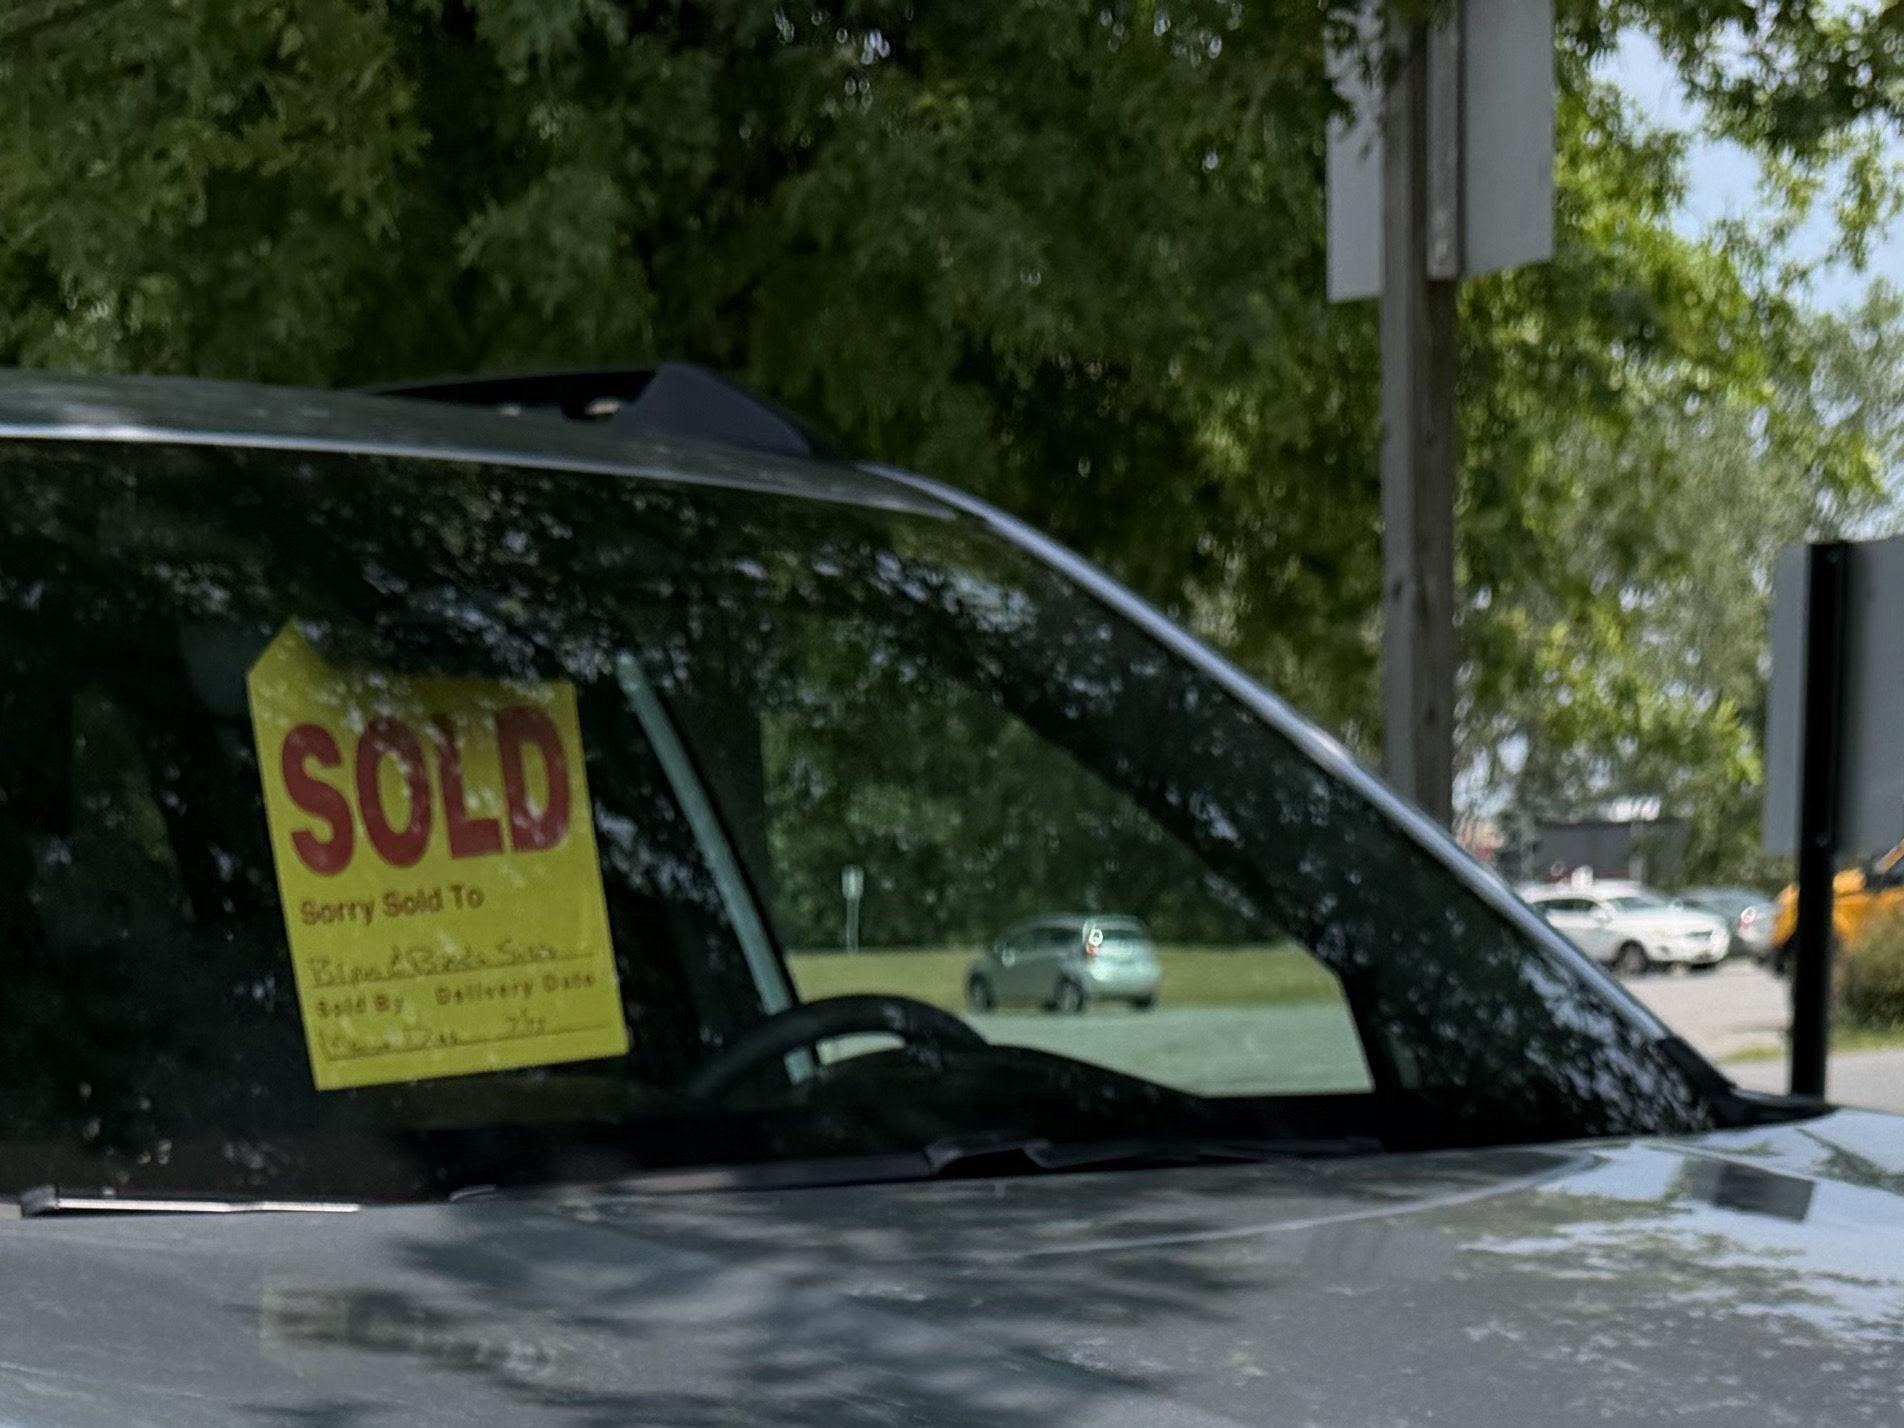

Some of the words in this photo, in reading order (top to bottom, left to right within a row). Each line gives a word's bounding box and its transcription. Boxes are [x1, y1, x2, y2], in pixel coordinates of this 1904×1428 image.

[282, 707, 569, 876] SOLD
[300, 899, 375, 926] Sorry
[383, 887, 444, 918] Sold
[449, 884, 485, 909] To
[542, 973, 594, 993] Date
[316, 996, 366, 1018] Sold
